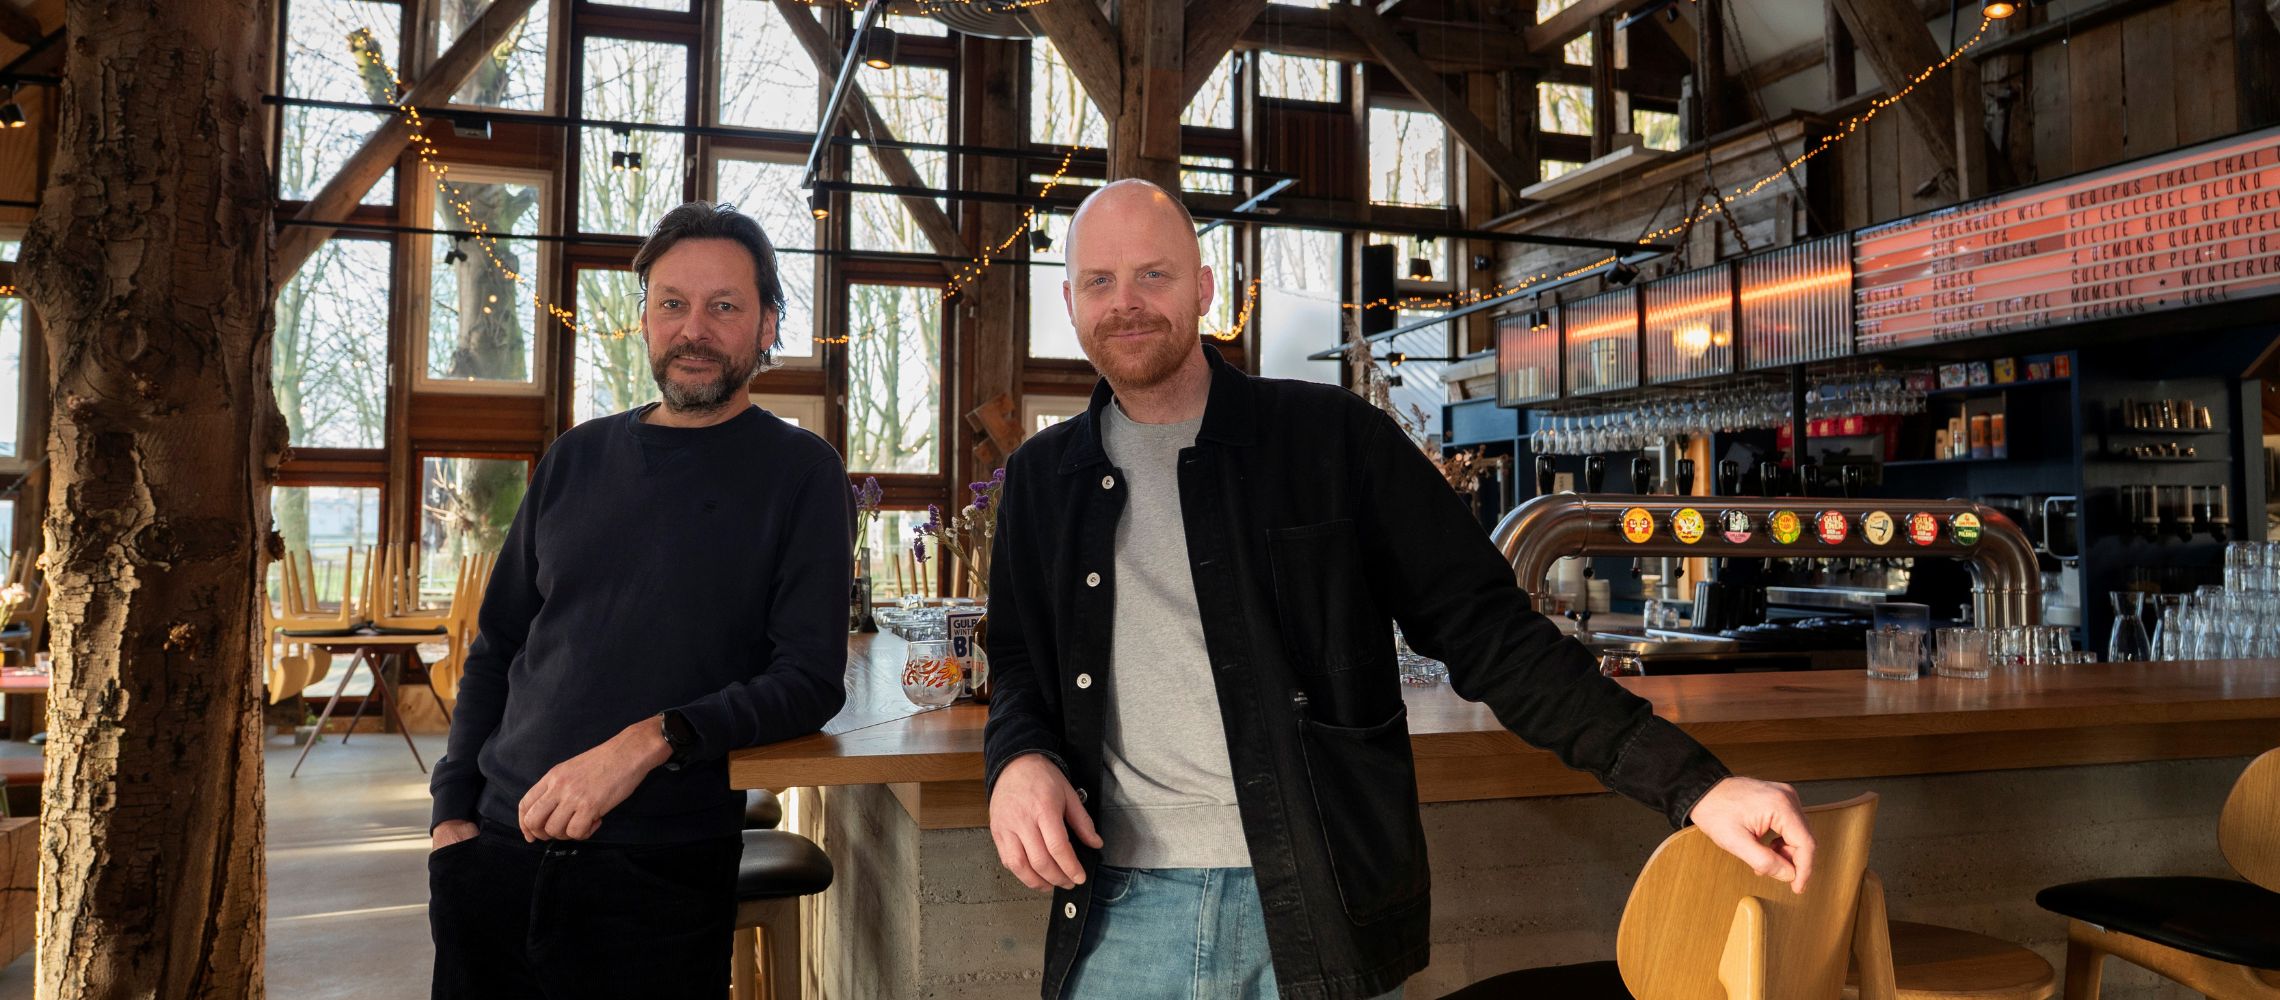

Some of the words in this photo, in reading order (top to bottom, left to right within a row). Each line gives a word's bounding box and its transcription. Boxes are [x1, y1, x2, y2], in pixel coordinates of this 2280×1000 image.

[2069, 179, 2141, 210] OEDIPUS
[2100, 190, 2187, 222] LELLEBEL
[2200, 172, 2261, 200] BLOND
[2145, 210, 2187, 232] BIRD
[2202, 202, 2221, 221] OF
[1984, 229, 2009, 246] IPA
[2092, 238, 2153, 262] DEMONS
[2169, 212, 2280, 247] QUADRUPEL
[2071, 256, 2156, 285] GULPENER
[2169, 243, 2227, 268] PLATO
[1996, 293, 2051, 315] TRIPEL
[2071, 281, 2134, 305] MOMENT
[2073, 298, 2145, 321] TAPDANS
